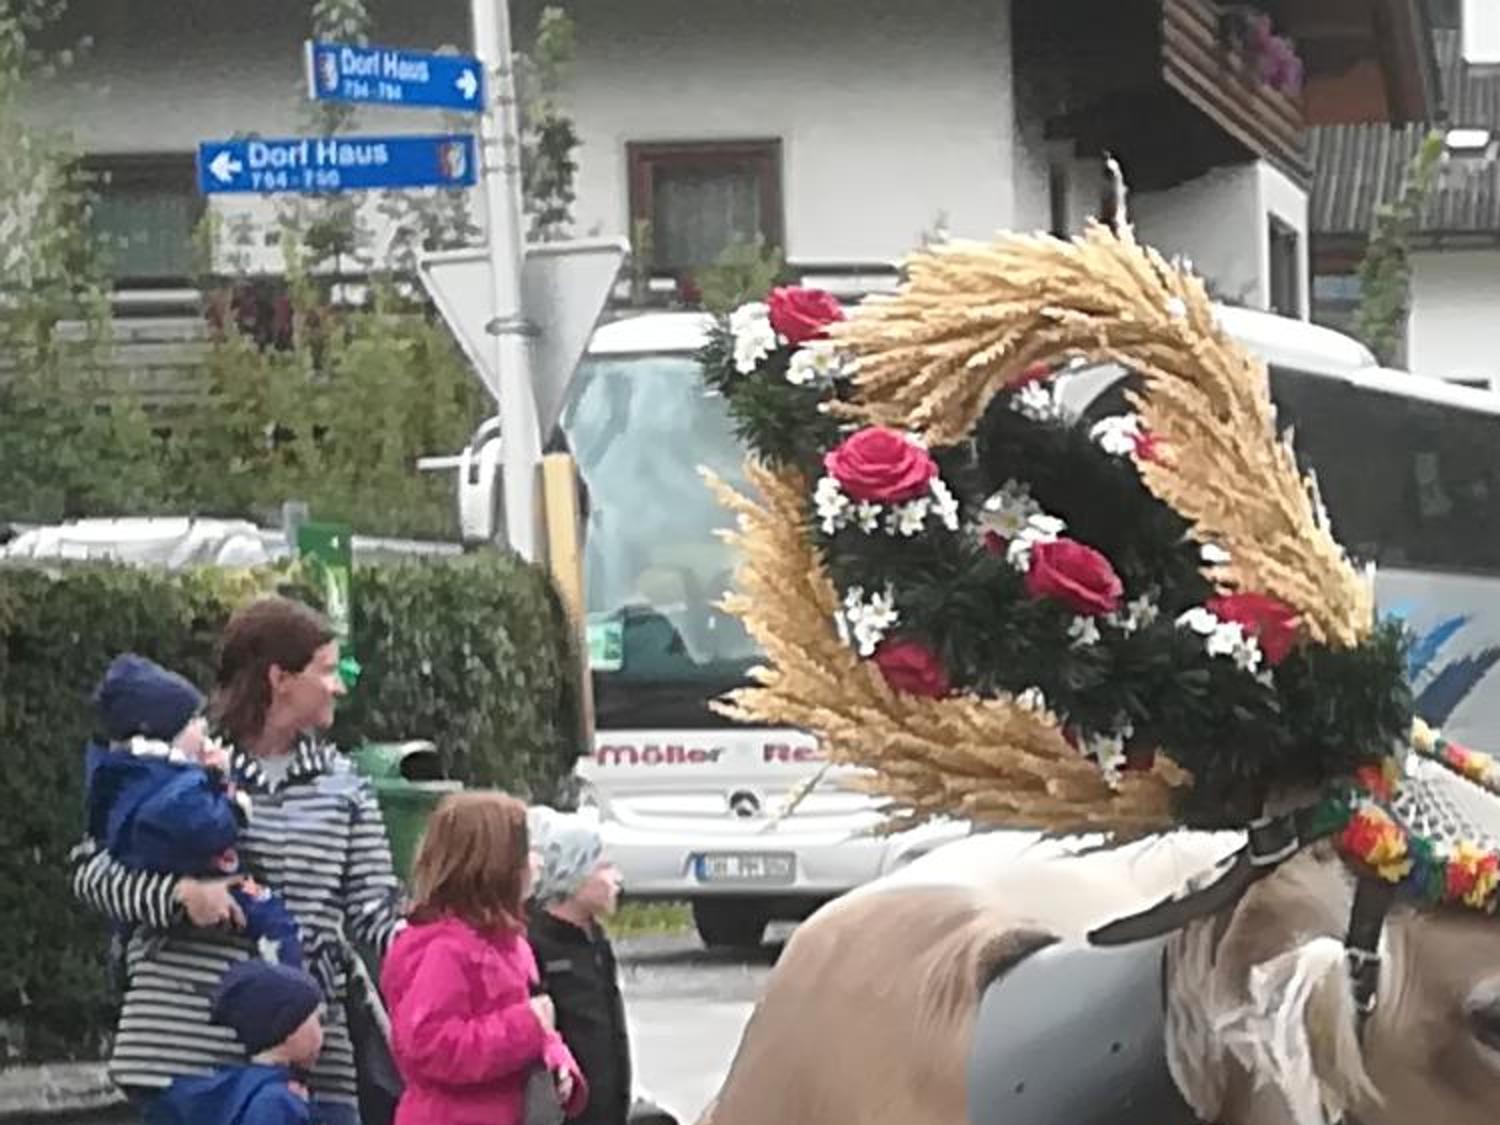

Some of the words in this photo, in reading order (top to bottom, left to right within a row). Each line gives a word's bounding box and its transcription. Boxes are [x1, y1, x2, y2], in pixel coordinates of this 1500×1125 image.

[341, 48, 380, 77] Dorf
[383, 52, 429, 83] Haus
[248, 140, 309, 169] Dorf
[316, 139, 389, 167] Haus
